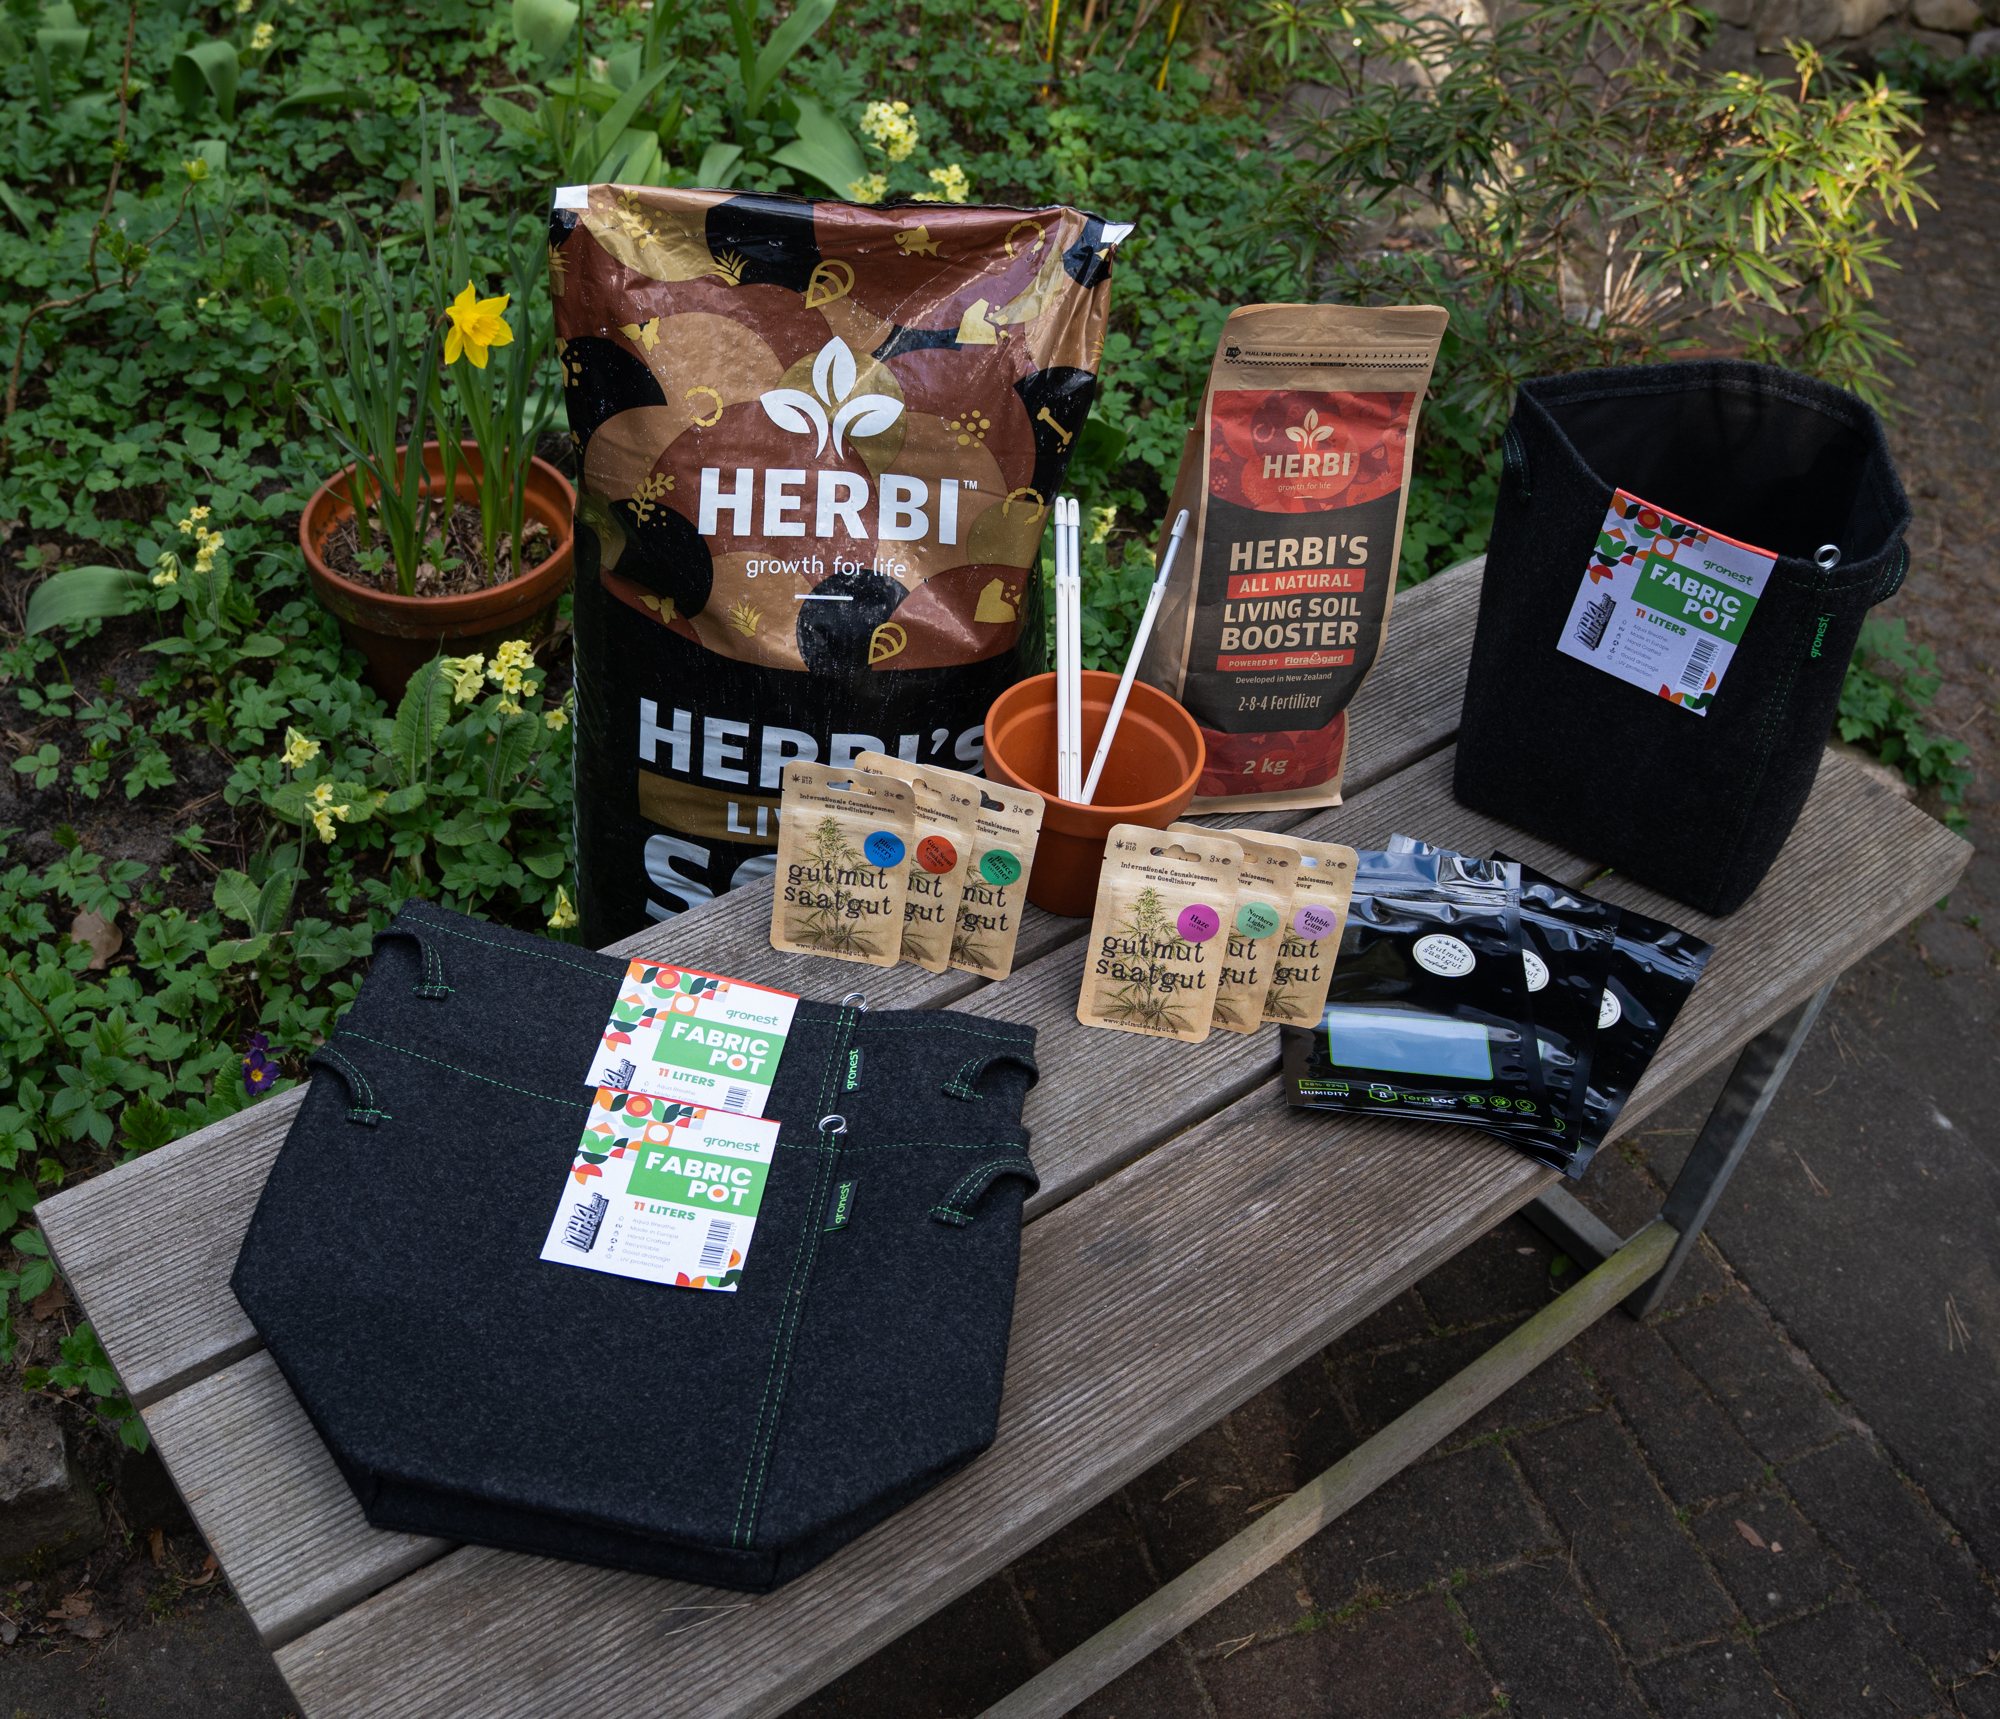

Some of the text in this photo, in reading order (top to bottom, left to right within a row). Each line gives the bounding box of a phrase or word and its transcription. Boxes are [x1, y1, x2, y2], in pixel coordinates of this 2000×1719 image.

[1262, 452, 1352, 479] HERBI
[1278, 482, 1331, 492] growth for life
[697, 467, 959, 546] HERBI
[1229, 534, 1369, 572] HERBI'S
[746, 556, 908, 580] growth for life
[1703, 559, 1754, 586] gronest
[1239, 573, 1352, 593] ALL NATURAL
[1650, 564, 1742, 614] FABRIC
[1224, 597, 1362, 623] LIVING SOIL
[1683, 598, 1736, 631] POT
[1220, 621, 1359, 650] BOOSTER
[1648, 614, 1688, 636] LITERS
[1810, 616, 1830, 658] gronest
[1228, 658, 1268, 668] POWERED
[1268, 658, 1278, 666] BY
[1236, 676, 1275, 685] Developed
[1286, 674, 1302, 682] New
[1304, 672, 1332, 682] Zealand
[1238, 694, 1322, 712] 2-8-4 Fertilizer
[1242, 758, 1288, 775] 2 kg
[788, 860, 888, 890] gutmut
[1120, 862, 1168, 875] Internationale
[784, 886, 892, 918] saatgut
[1190, 914, 1210, 929] Haze
[1247, 908, 1274, 927] Northern
[1247, 916, 1266, 930] Lights
[1304, 910, 1330, 928] Bubble
[1304, 918, 1323, 932] Gum
[1101, 932, 1205, 964] gutmut
[1422, 948, 1462, 970] saatgut
[1428, 943, 1465, 964] gutmut
[1096, 958, 1207, 993] saatgut
[726, 1008, 778, 1026] gronest
[671, 1021, 770, 1056] FABRIC
[708, 1055, 766, 1076] POT
[846, 1049, 858, 1090] gronest
[672, 1071, 716, 1088] LITERS
[703, 1136, 760, 1152] gronest
[645, 1152, 752, 1186] FABRIC
[688, 1184, 750, 1206] POT
[834, 1183, 851, 1224] gronest
[649, 1202, 696, 1221] LITERS
